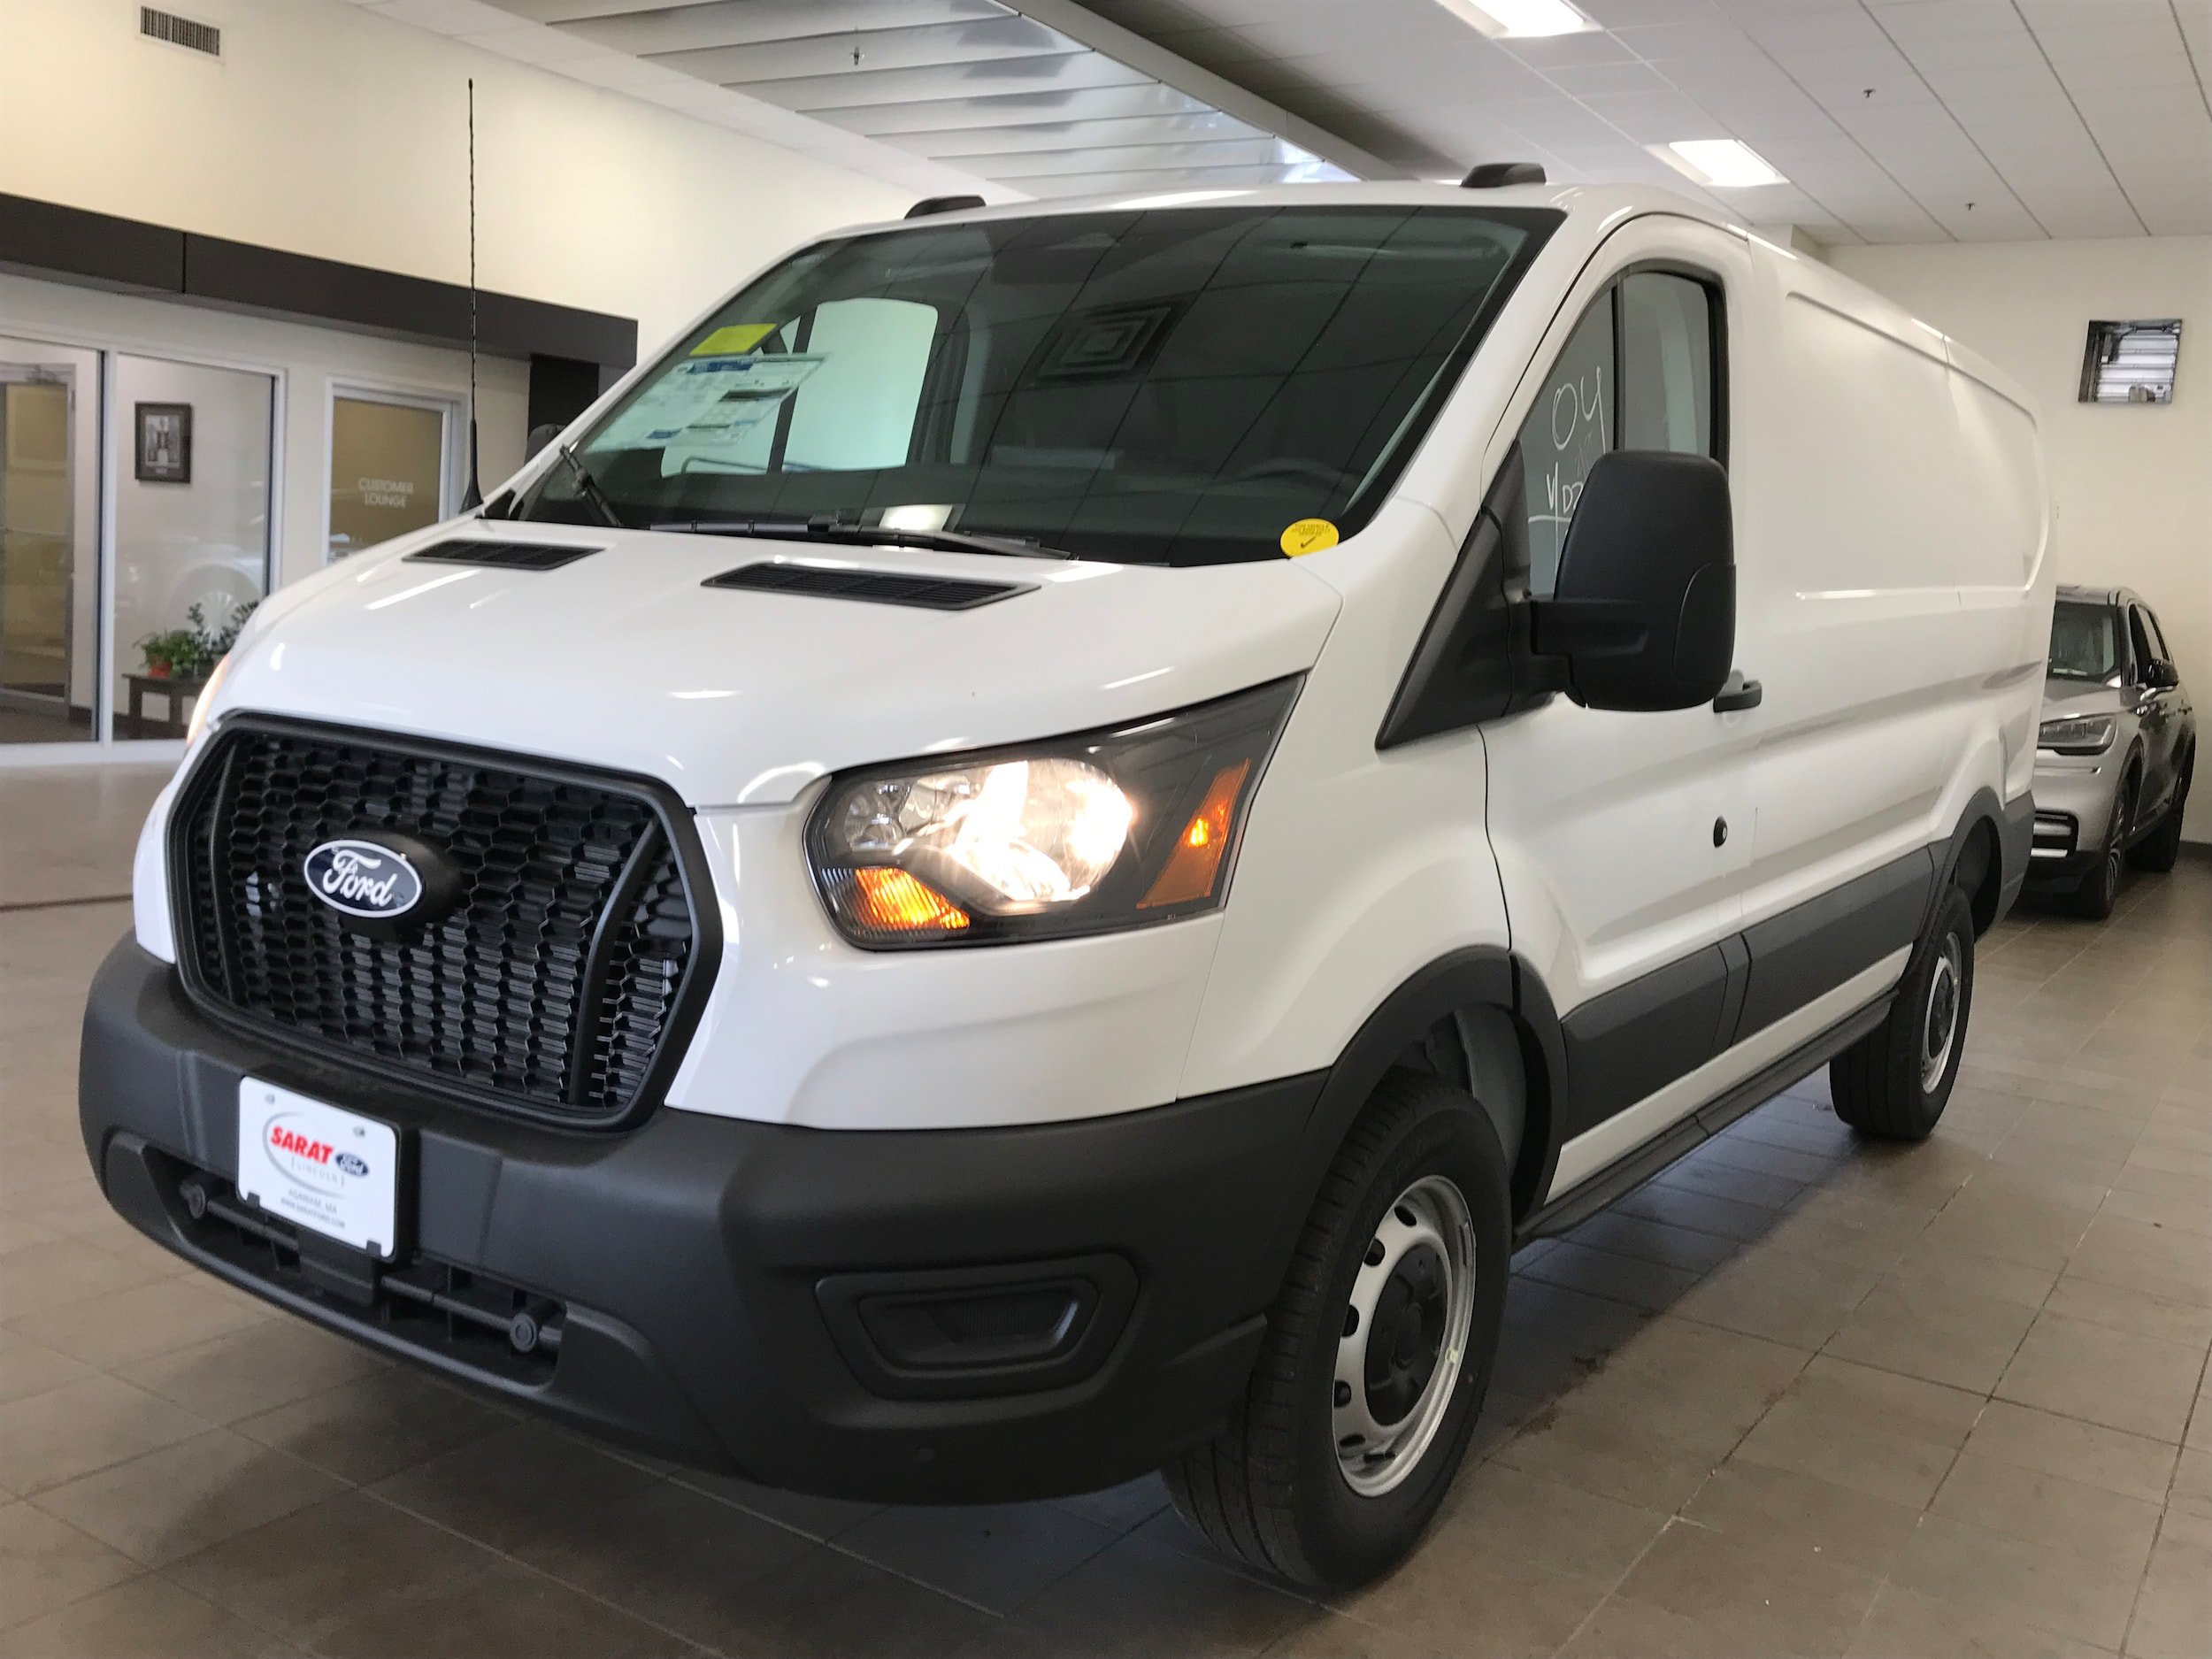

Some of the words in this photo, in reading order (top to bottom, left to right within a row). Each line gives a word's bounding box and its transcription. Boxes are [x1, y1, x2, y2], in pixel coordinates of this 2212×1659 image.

[358, 478, 413, 494] CUSTOMER
[365, 491, 406, 509] LOUNGE
[322, 849, 398, 907] Ford
[270, 1125, 334, 1165] SARAT
